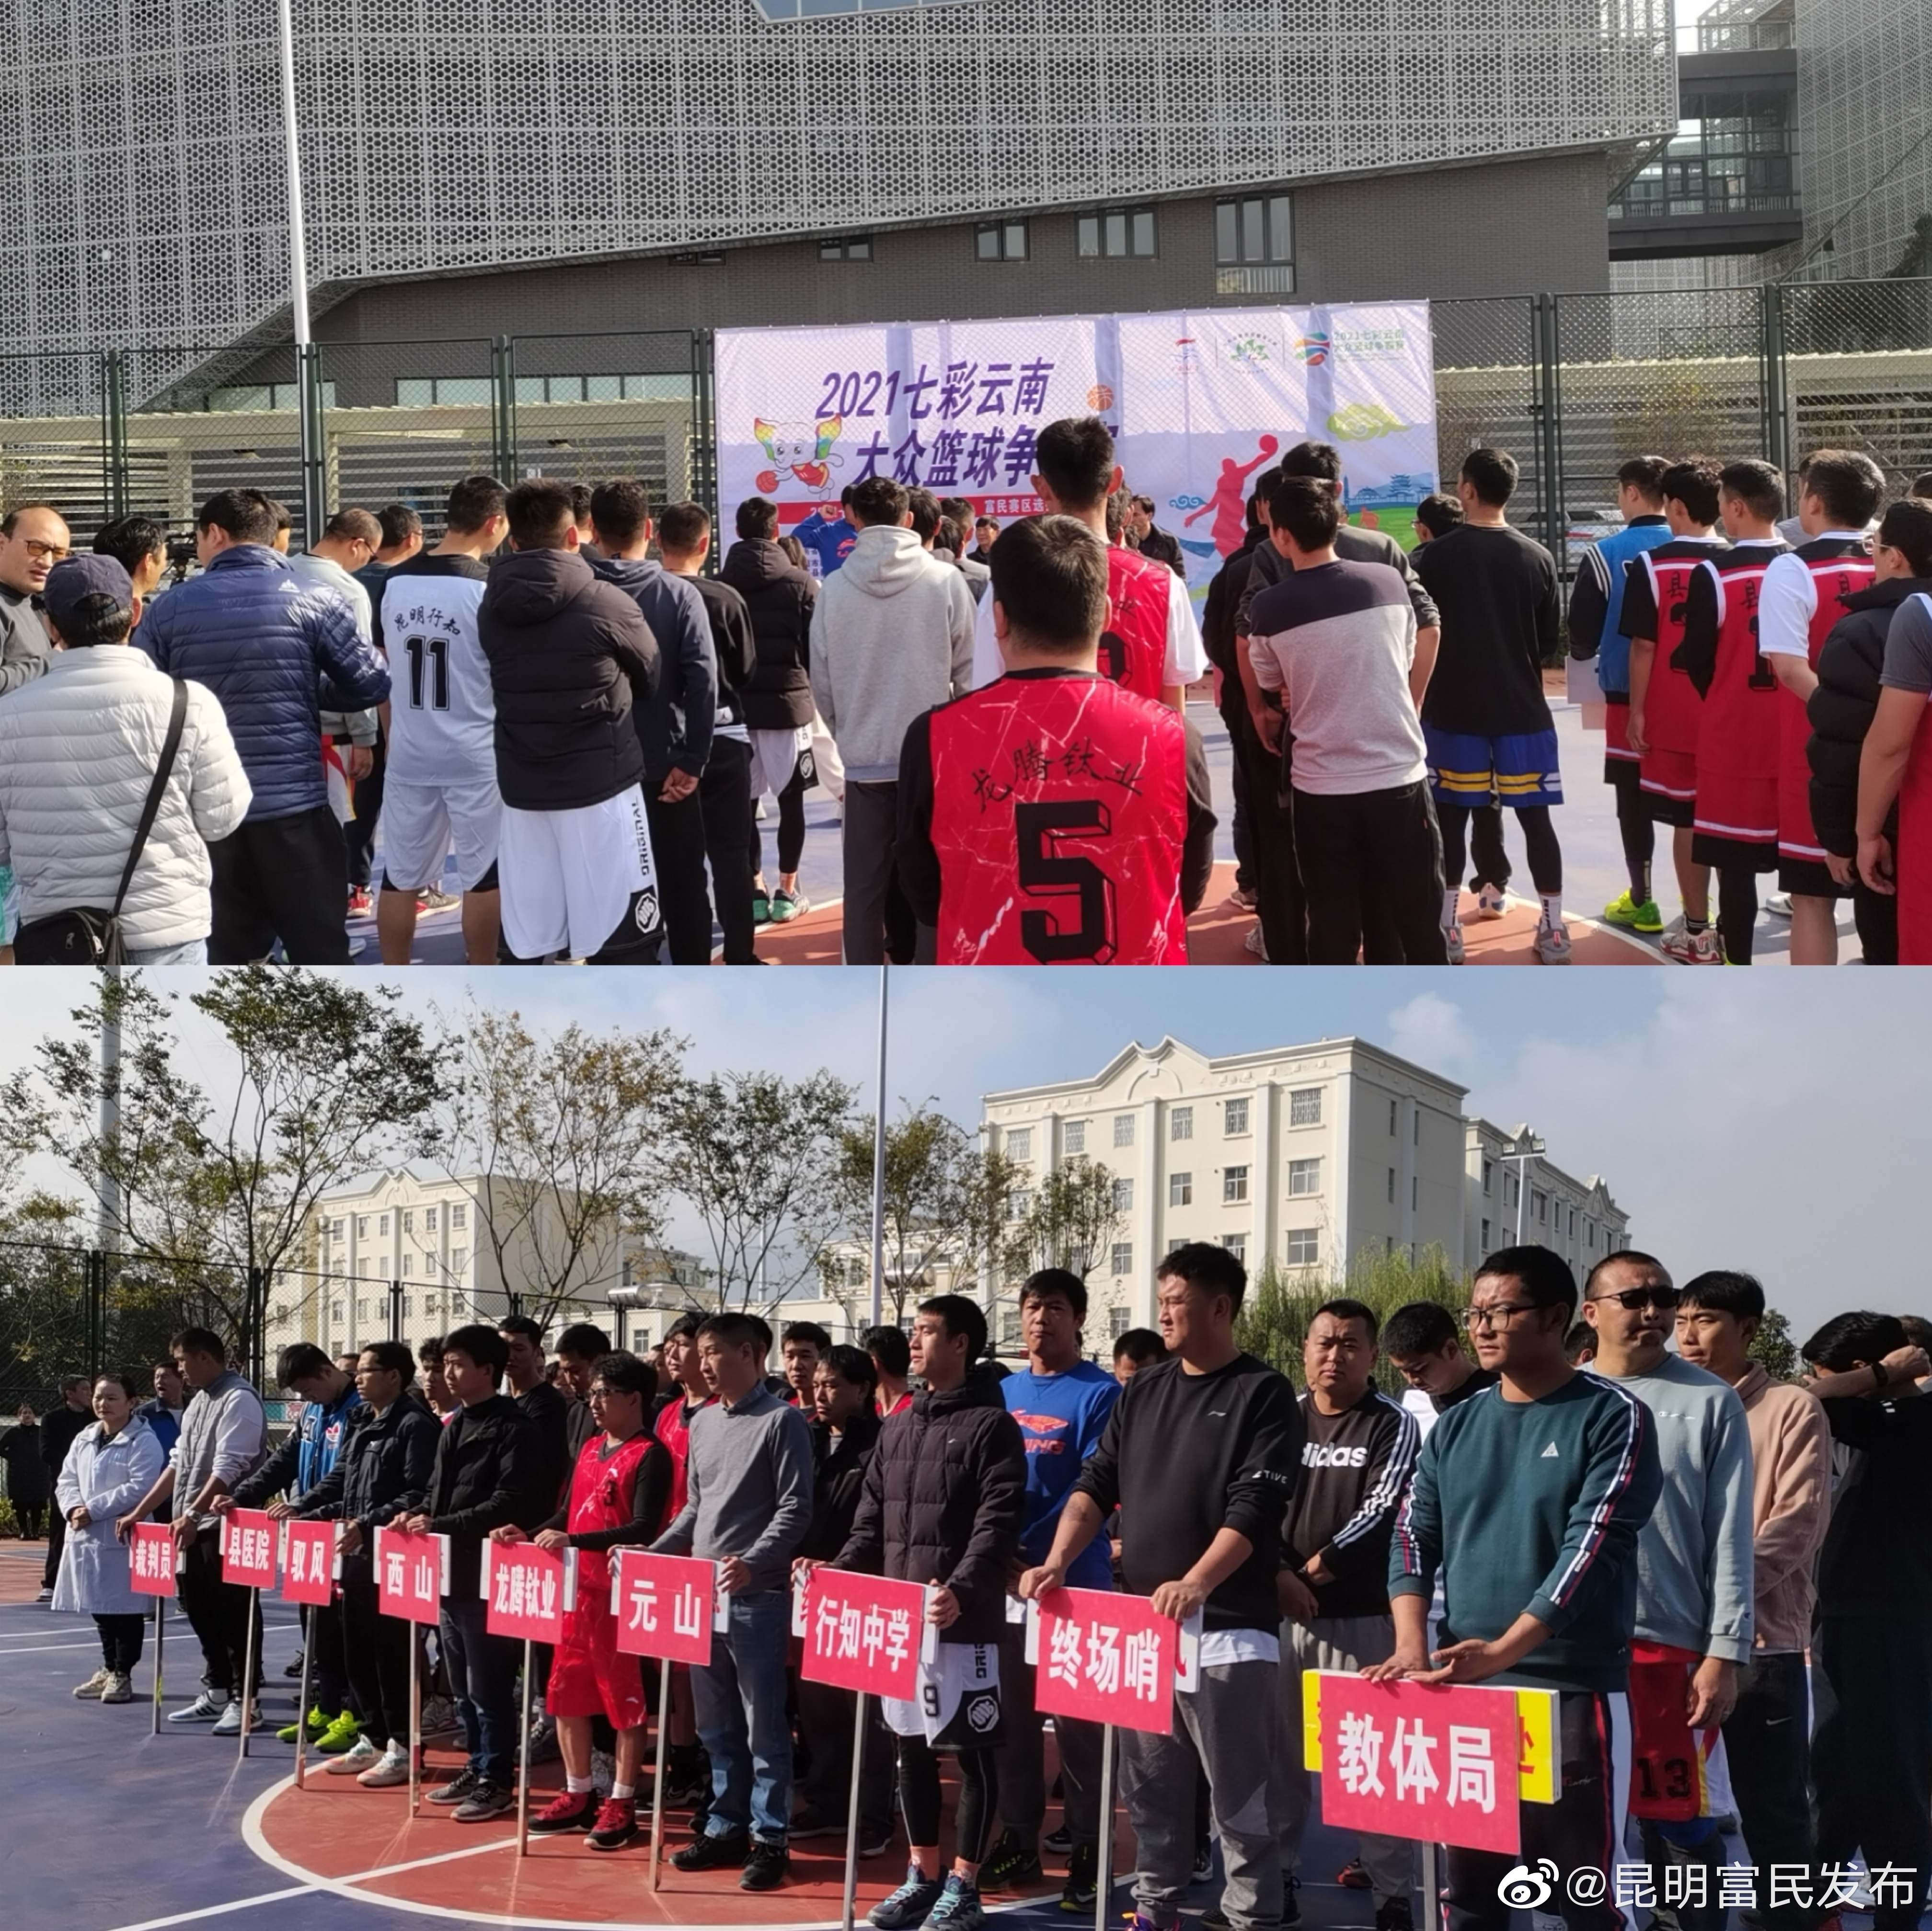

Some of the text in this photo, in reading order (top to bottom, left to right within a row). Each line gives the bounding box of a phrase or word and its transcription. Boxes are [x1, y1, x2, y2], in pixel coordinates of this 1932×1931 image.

[815, 357, 1054, 420] 2021七彩云南
[853, 425, 1039, 488] 大众篮球争
[984, 498, 1049, 514] 富民赛区选
[404, 634, 450, 711] 11
[1015, 799, 1117, 965] 5
[1300, 1442, 1368, 1468] didas
[135, 1540, 171, 1580] 裁判员
[228, 1527, 270, 1571] 县医院
[290, 1540, 325, 1586] 驭风
[386, 1552, 432, 1602] 西山
[494, 1563, 556, 1620] 龙腾钛业
[629, 1579, 701, 1639] 元山
[816, 1595, 910, 1673] 行知中学
[1048, 1618, 1161, 1703] 终场哨
[924, 1685, 940, 1717] 9
[1337, 1711, 1495, 1814] 教体局
[1637, 1758, 1691, 1799] 13
